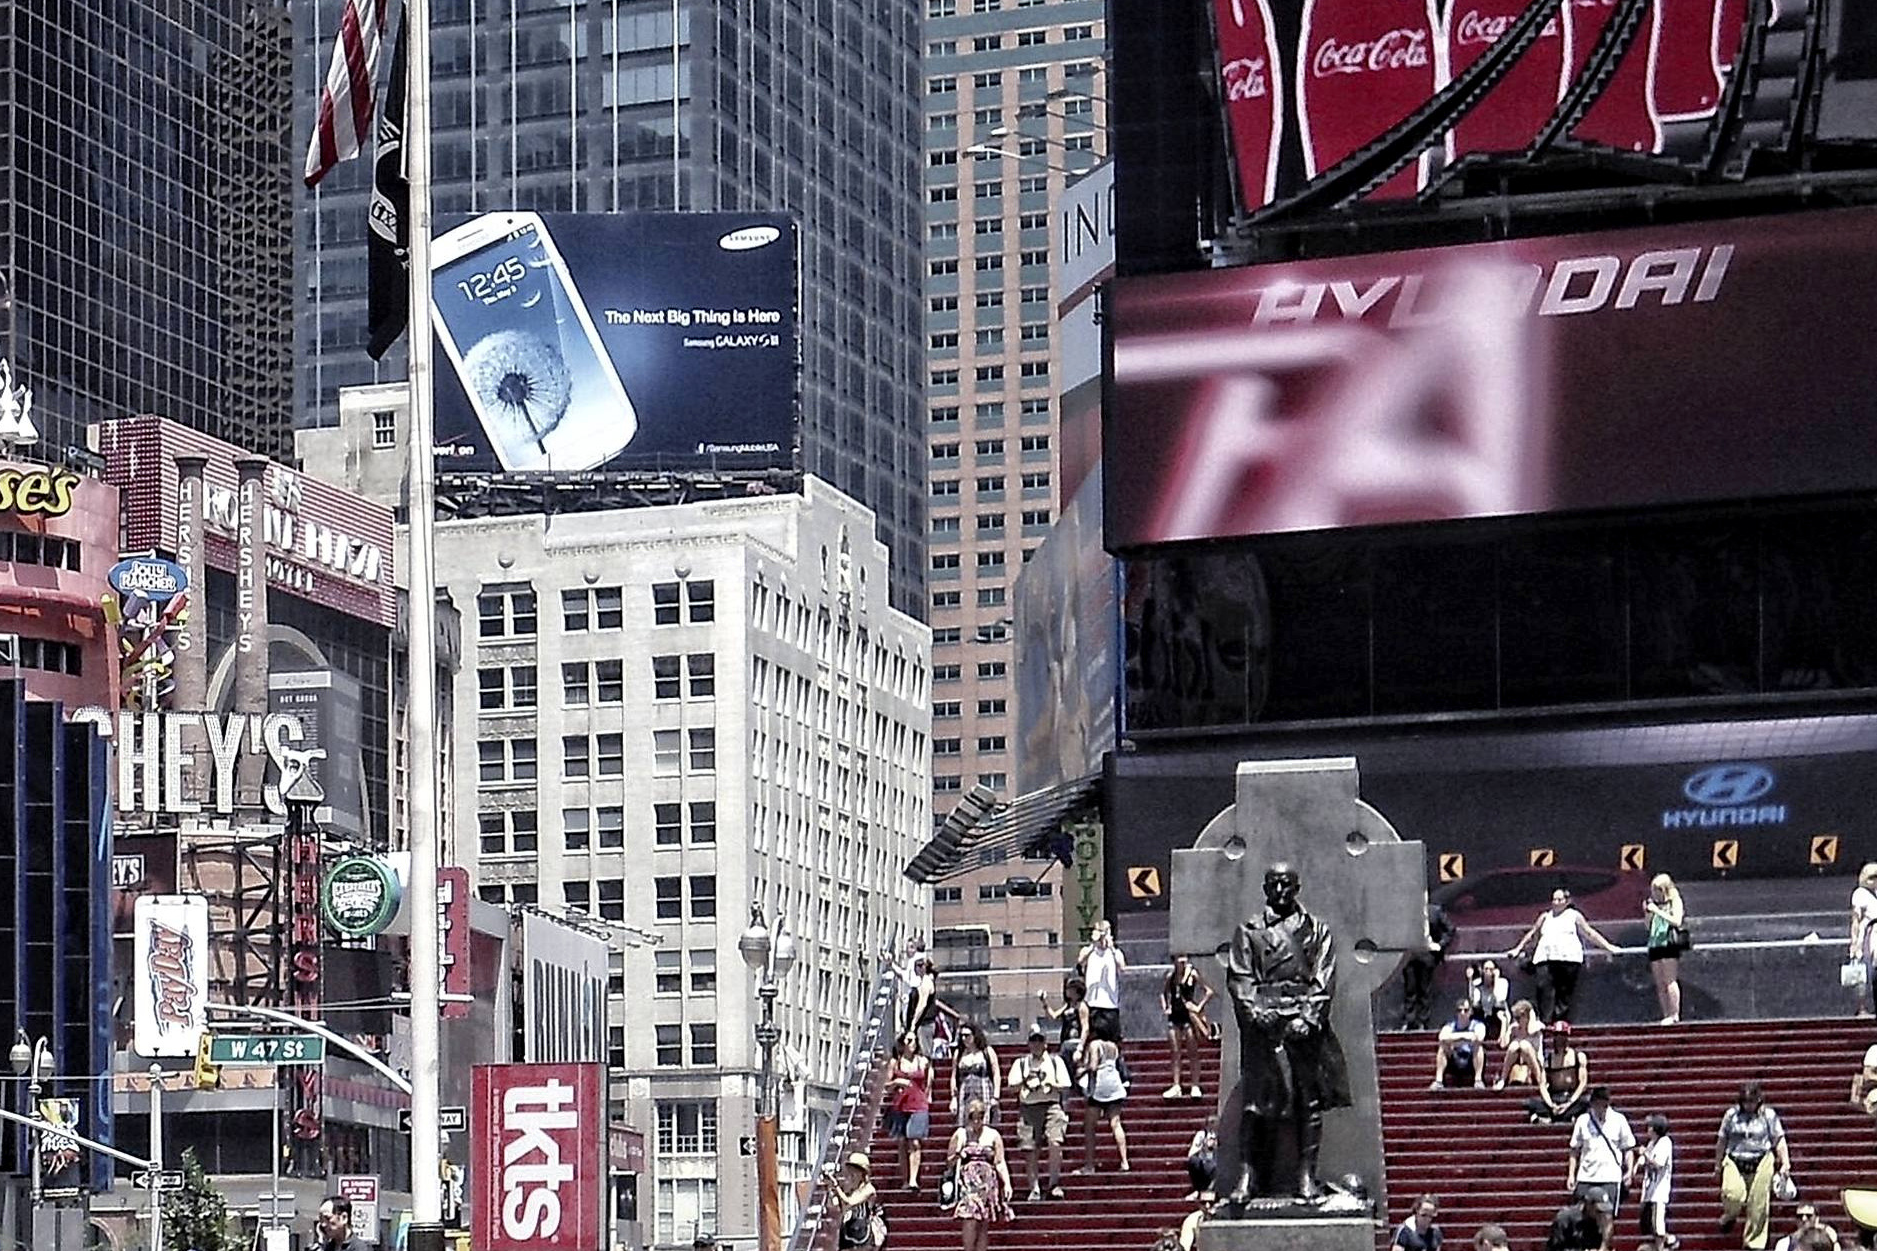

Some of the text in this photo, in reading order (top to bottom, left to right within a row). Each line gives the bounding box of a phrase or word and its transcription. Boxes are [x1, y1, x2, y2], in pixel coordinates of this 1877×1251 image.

[1313, 28, 1428, 78] Coca-Cola
[1063, 182, 1115, 265] IN
[457, 256, 526, 302] 12:45
[604, 310, 631, 325] The
[633, 309, 665, 324] Next
[667, 309, 691, 327] Big
[692, 309, 731, 327] Thing
[748, 308, 781, 324] Here
[715, 335, 758, 347] GALAXY
[120, 572, 176, 592] RANCHER
[132, 561, 167, 577] JOLLY
[239, 482, 254, 653] HERSHEYS
[1662, 806, 1785, 829] HYUNDAI
[148, 919, 197, 1027] PayDay
[230, 1040, 305, 1059] W 47 St
[502, 1078, 579, 1241] tkts
